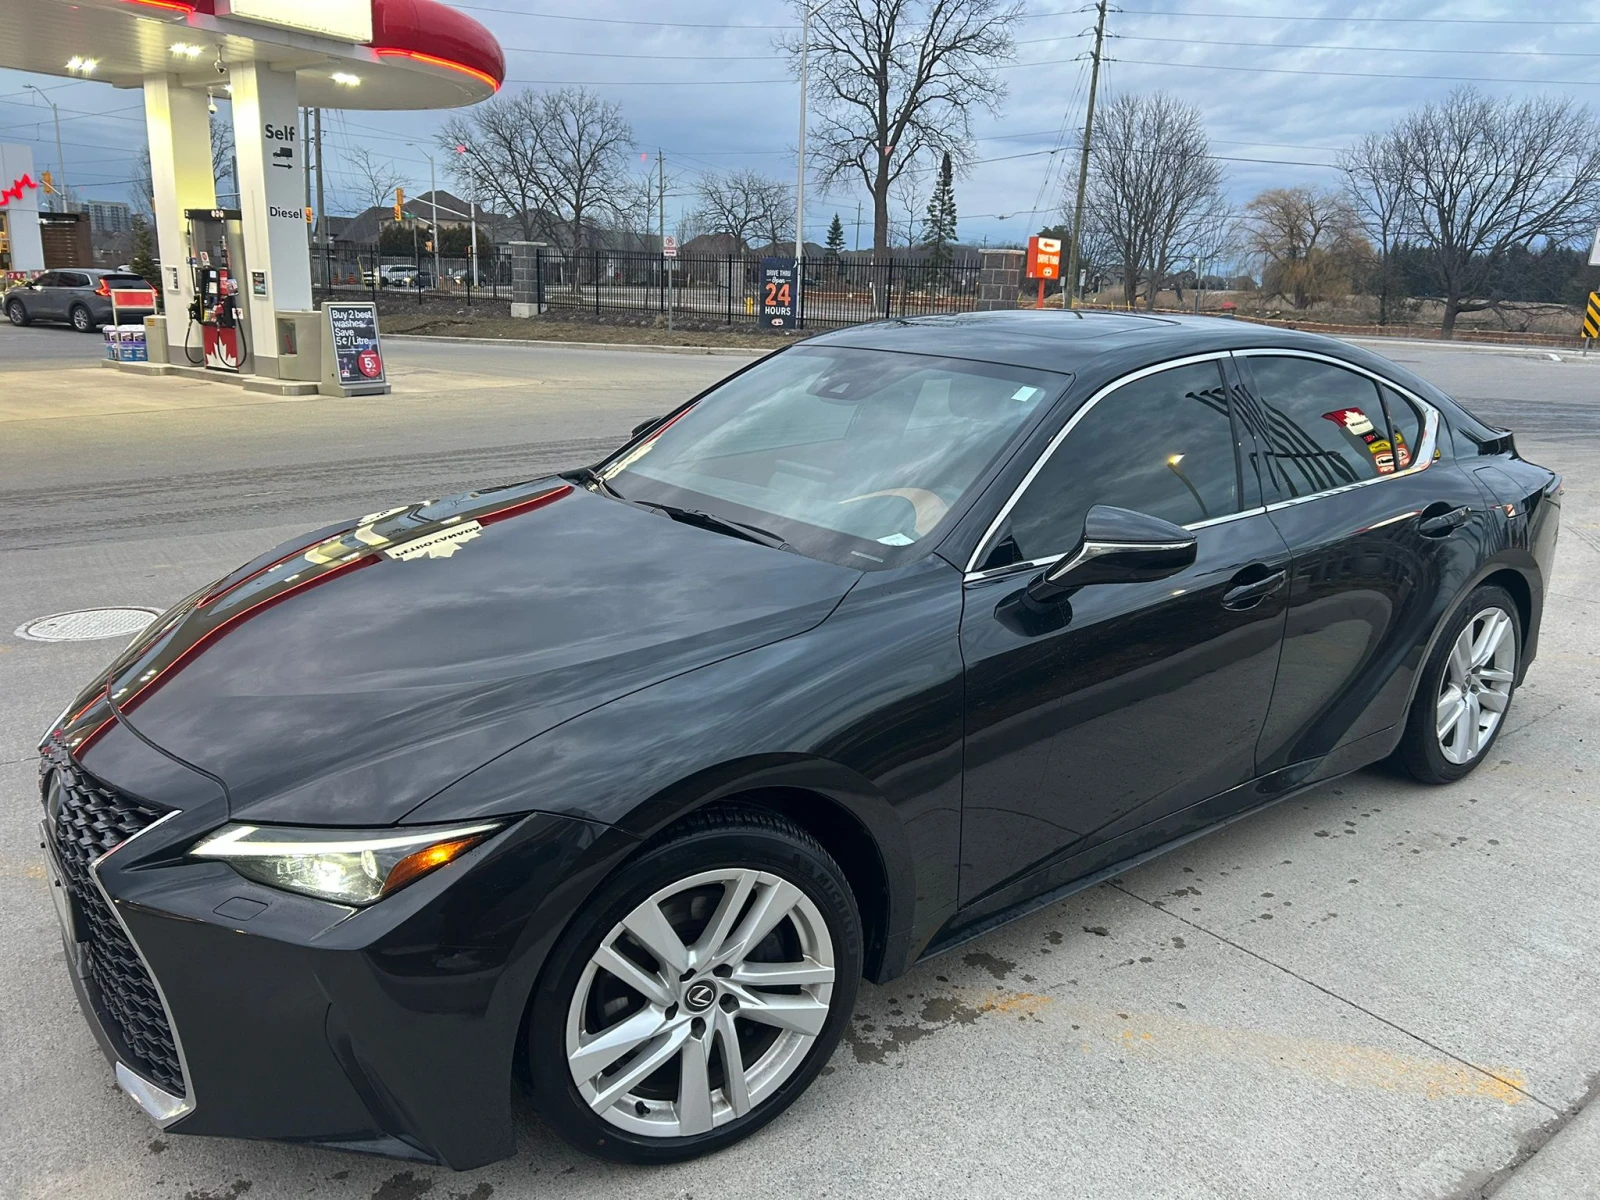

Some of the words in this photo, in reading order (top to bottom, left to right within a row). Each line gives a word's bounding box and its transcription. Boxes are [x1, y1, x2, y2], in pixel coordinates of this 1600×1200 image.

[265, 124, 295, 141] Self
[269, 206, 303, 219] Diesel
[765, 283, 790, 306] 24
[332, 310, 348, 320] Buy
[348, 310, 355, 319] 2
[355, 310, 373, 319] best
[765, 306, 791, 316] HOURS
[335, 328, 355, 337] Save
